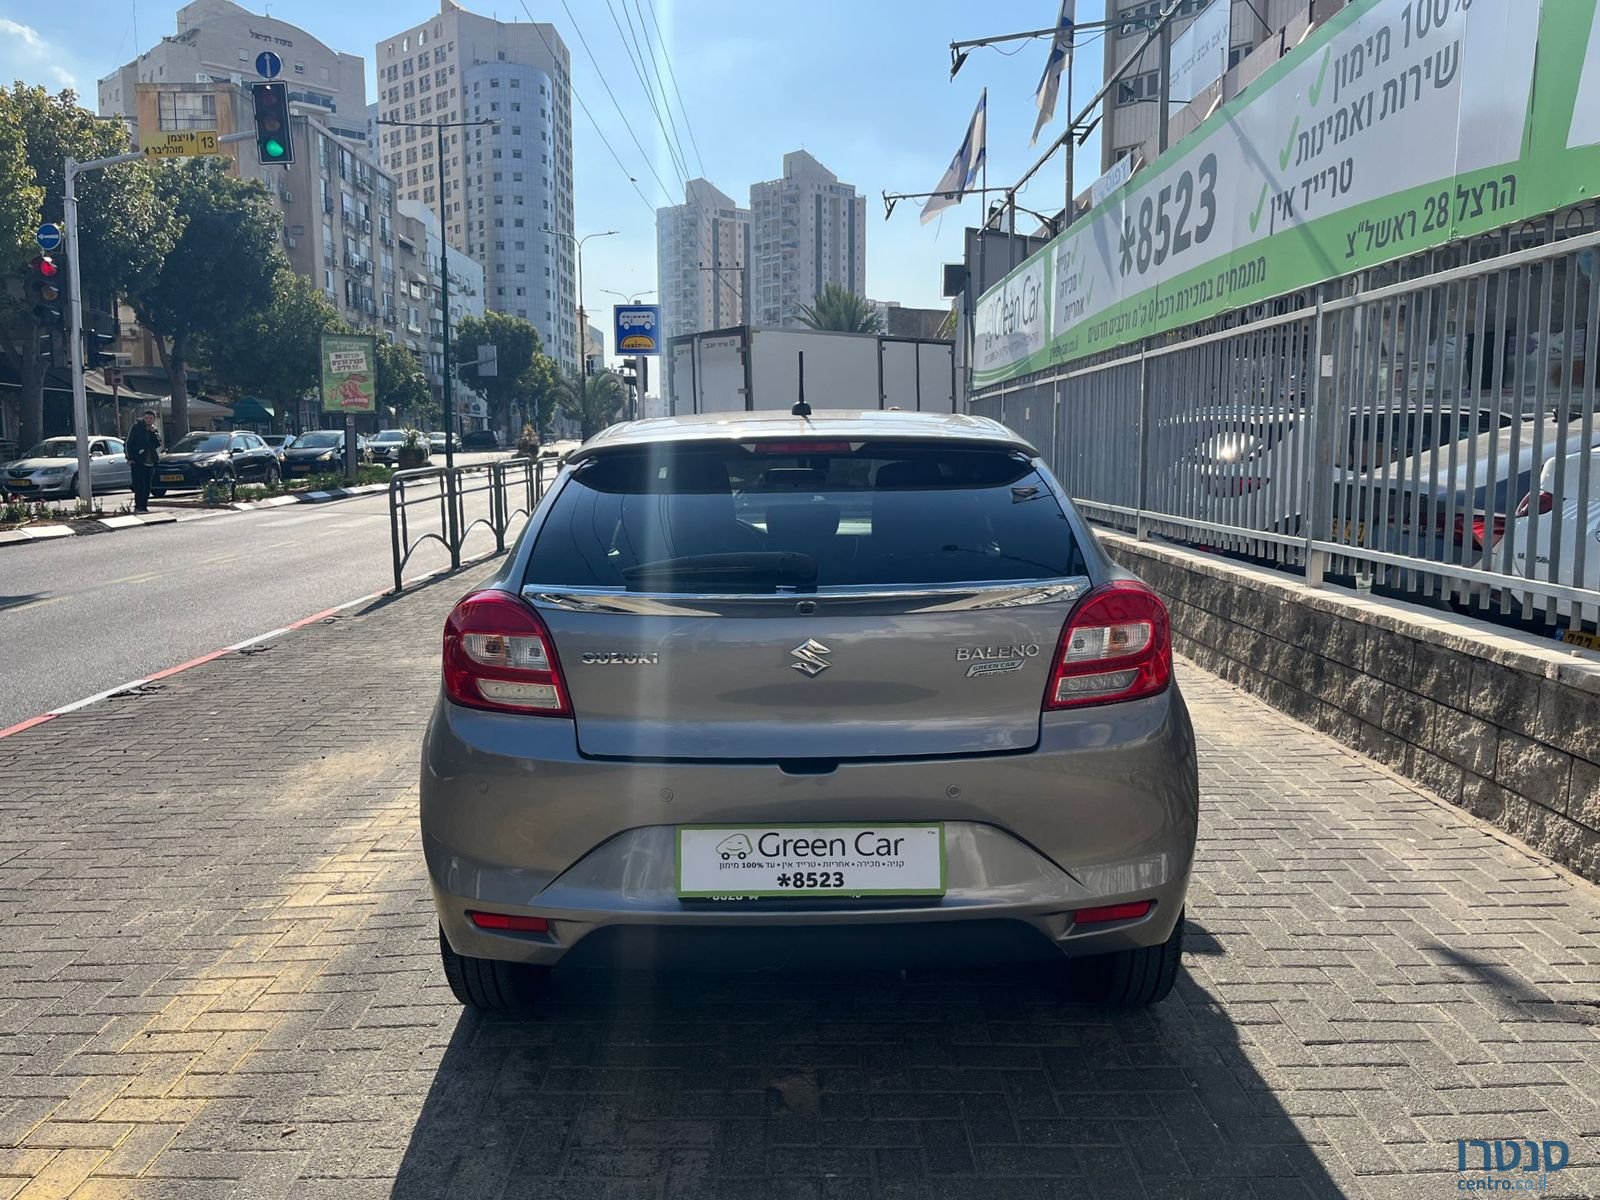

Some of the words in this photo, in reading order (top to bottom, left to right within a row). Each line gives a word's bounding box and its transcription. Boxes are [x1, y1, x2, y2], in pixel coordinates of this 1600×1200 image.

[1333, 26, 1391, 104] מימון
[1380, 40, 1460, 120] שירות
[1296, 91, 1374, 167] ואמינות
[167, 133, 189, 145] ויצמן
[201, 136, 215, 149] 13
[151, 144, 184, 155] מוהליבר
[1302, 157, 1353, 211] טרייד
[1456, 174, 1517, 222] הרצל
[1269, 186, 1297, 237] אין
[1422, 191, 1450, 234] 28
[1345, 209, 1417, 259] ראשל"צ
[1216, 256, 1266, 298] מתמחים
[1022, 274, 1042, 325] Car
[1176, 278, 1213, 312] במכירת
[581, 651, 659, 665] SUZUKI
[956, 643, 1040, 661] BALENO
[973, 663, 999, 672] GREEN
[1000, 661, 1016, 669] CAR
[758, 832, 846, 858] Green
[854, 831, 905, 857] Car
[719, 862, 740, 870] מימון
[765, 861, 776, 870] עד
[781, 861, 795, 870] אין
[795, 860, 817, 868] טרייד
[822, 860, 851, 868] אחריות
[856, 860, 881, 868] מכירה
[886, 860, 905, 869] קניה
